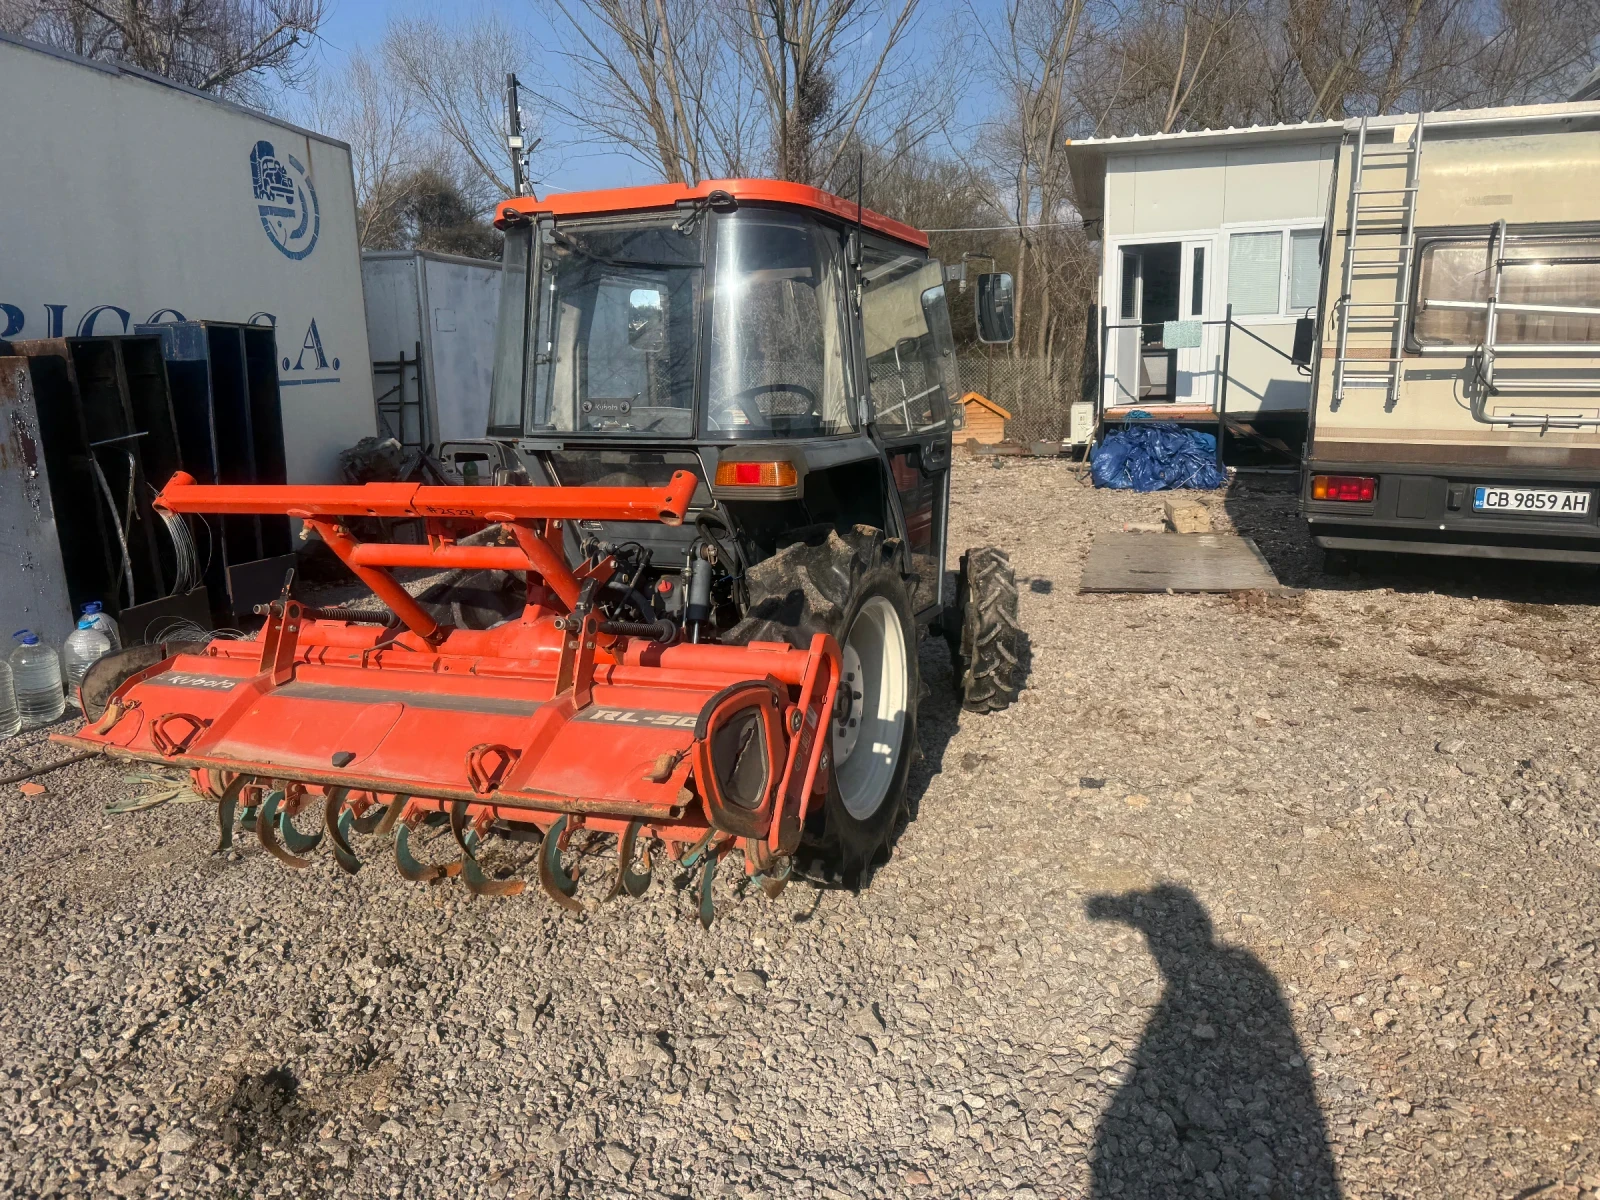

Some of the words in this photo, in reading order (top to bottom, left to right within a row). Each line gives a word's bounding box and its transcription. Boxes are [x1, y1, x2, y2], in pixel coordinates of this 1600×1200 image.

[1486, 491, 1509, 507] CB
[1514, 492, 1558, 510] 9859
[1561, 495, 1587, 511] AH
